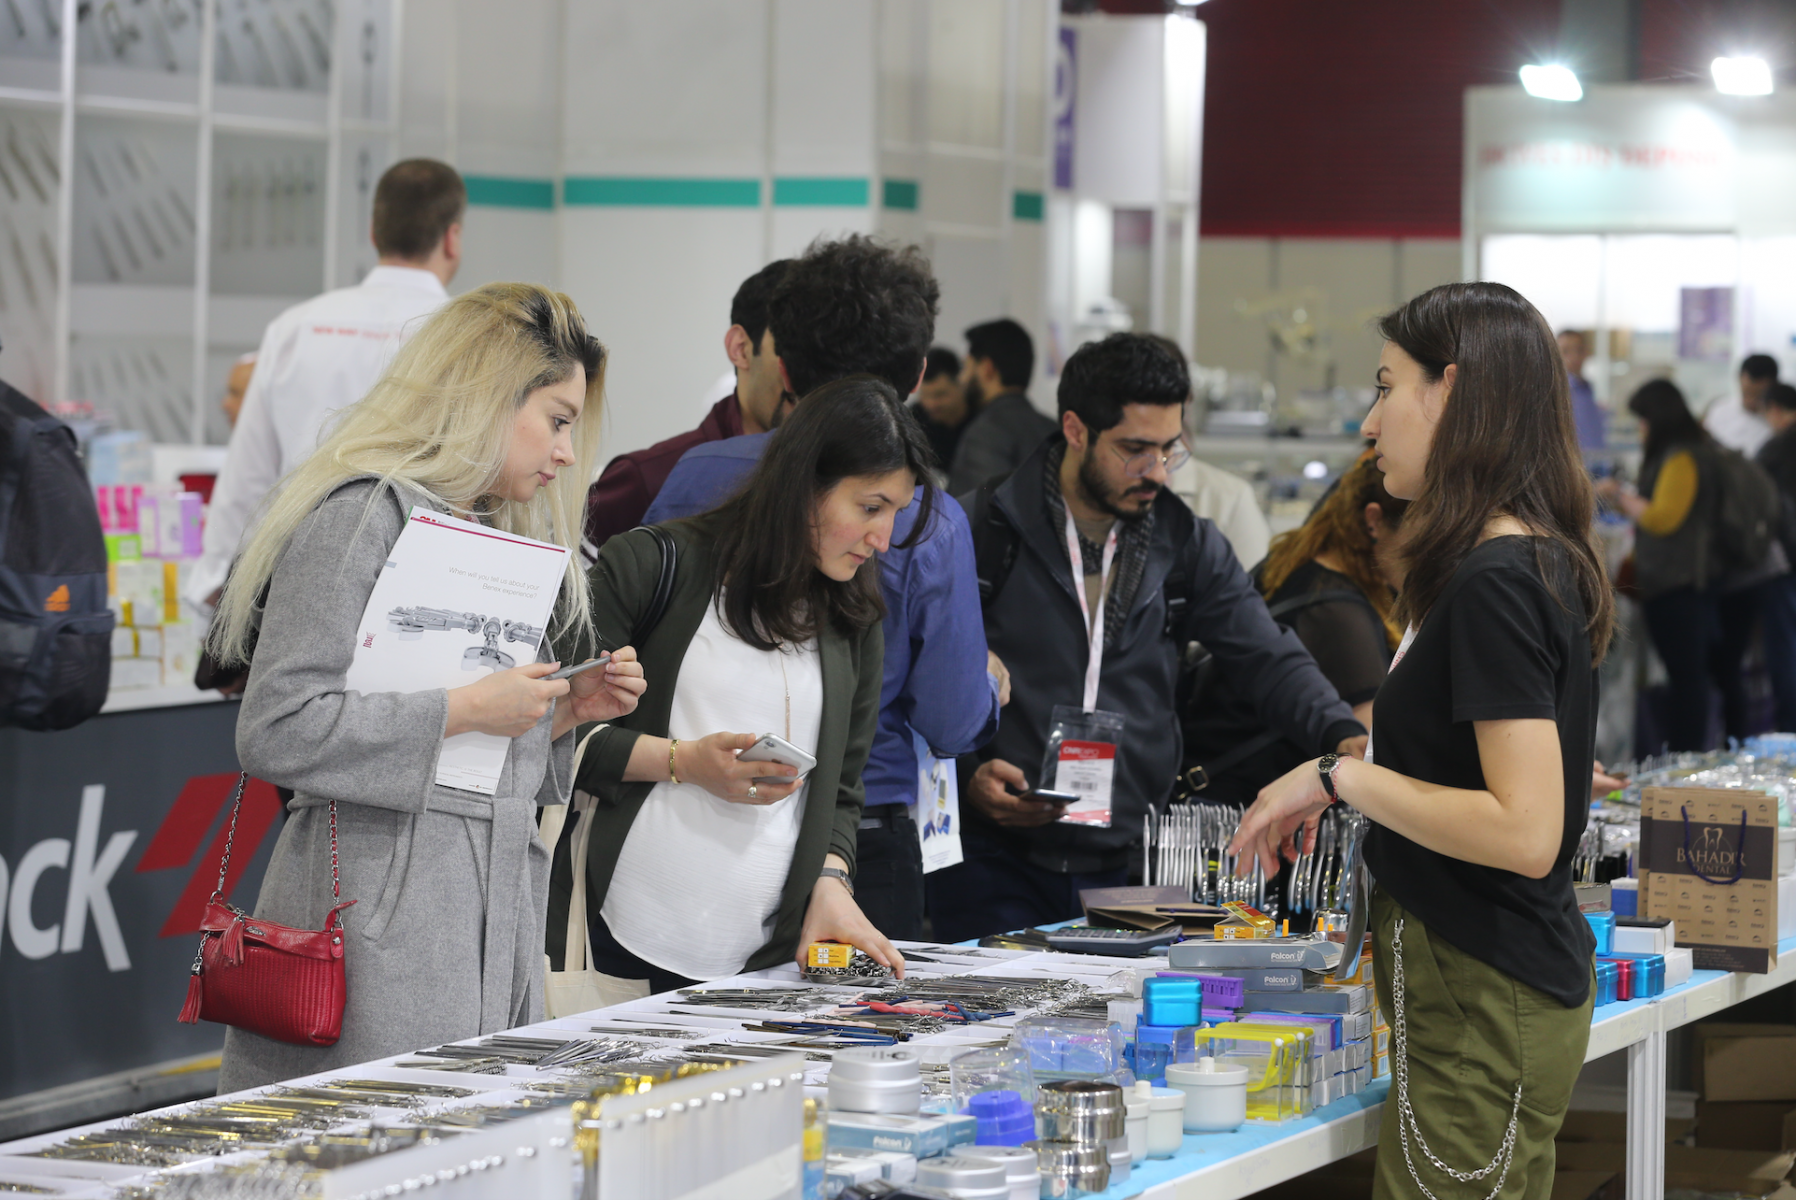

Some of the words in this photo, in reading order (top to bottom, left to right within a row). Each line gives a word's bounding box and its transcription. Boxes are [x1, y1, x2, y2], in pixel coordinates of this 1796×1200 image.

[448, 566, 467, 576] When
[508, 579, 526, 587] about
[526, 583, 540, 591] your
[482, 583, 501, 592] Benex
[502, 588, 537, 598] experience?
[0, 784, 139, 972] ck
[1270, 952, 1295, 960] Falcon
[1264, 976, 1289, 984] Falcon
